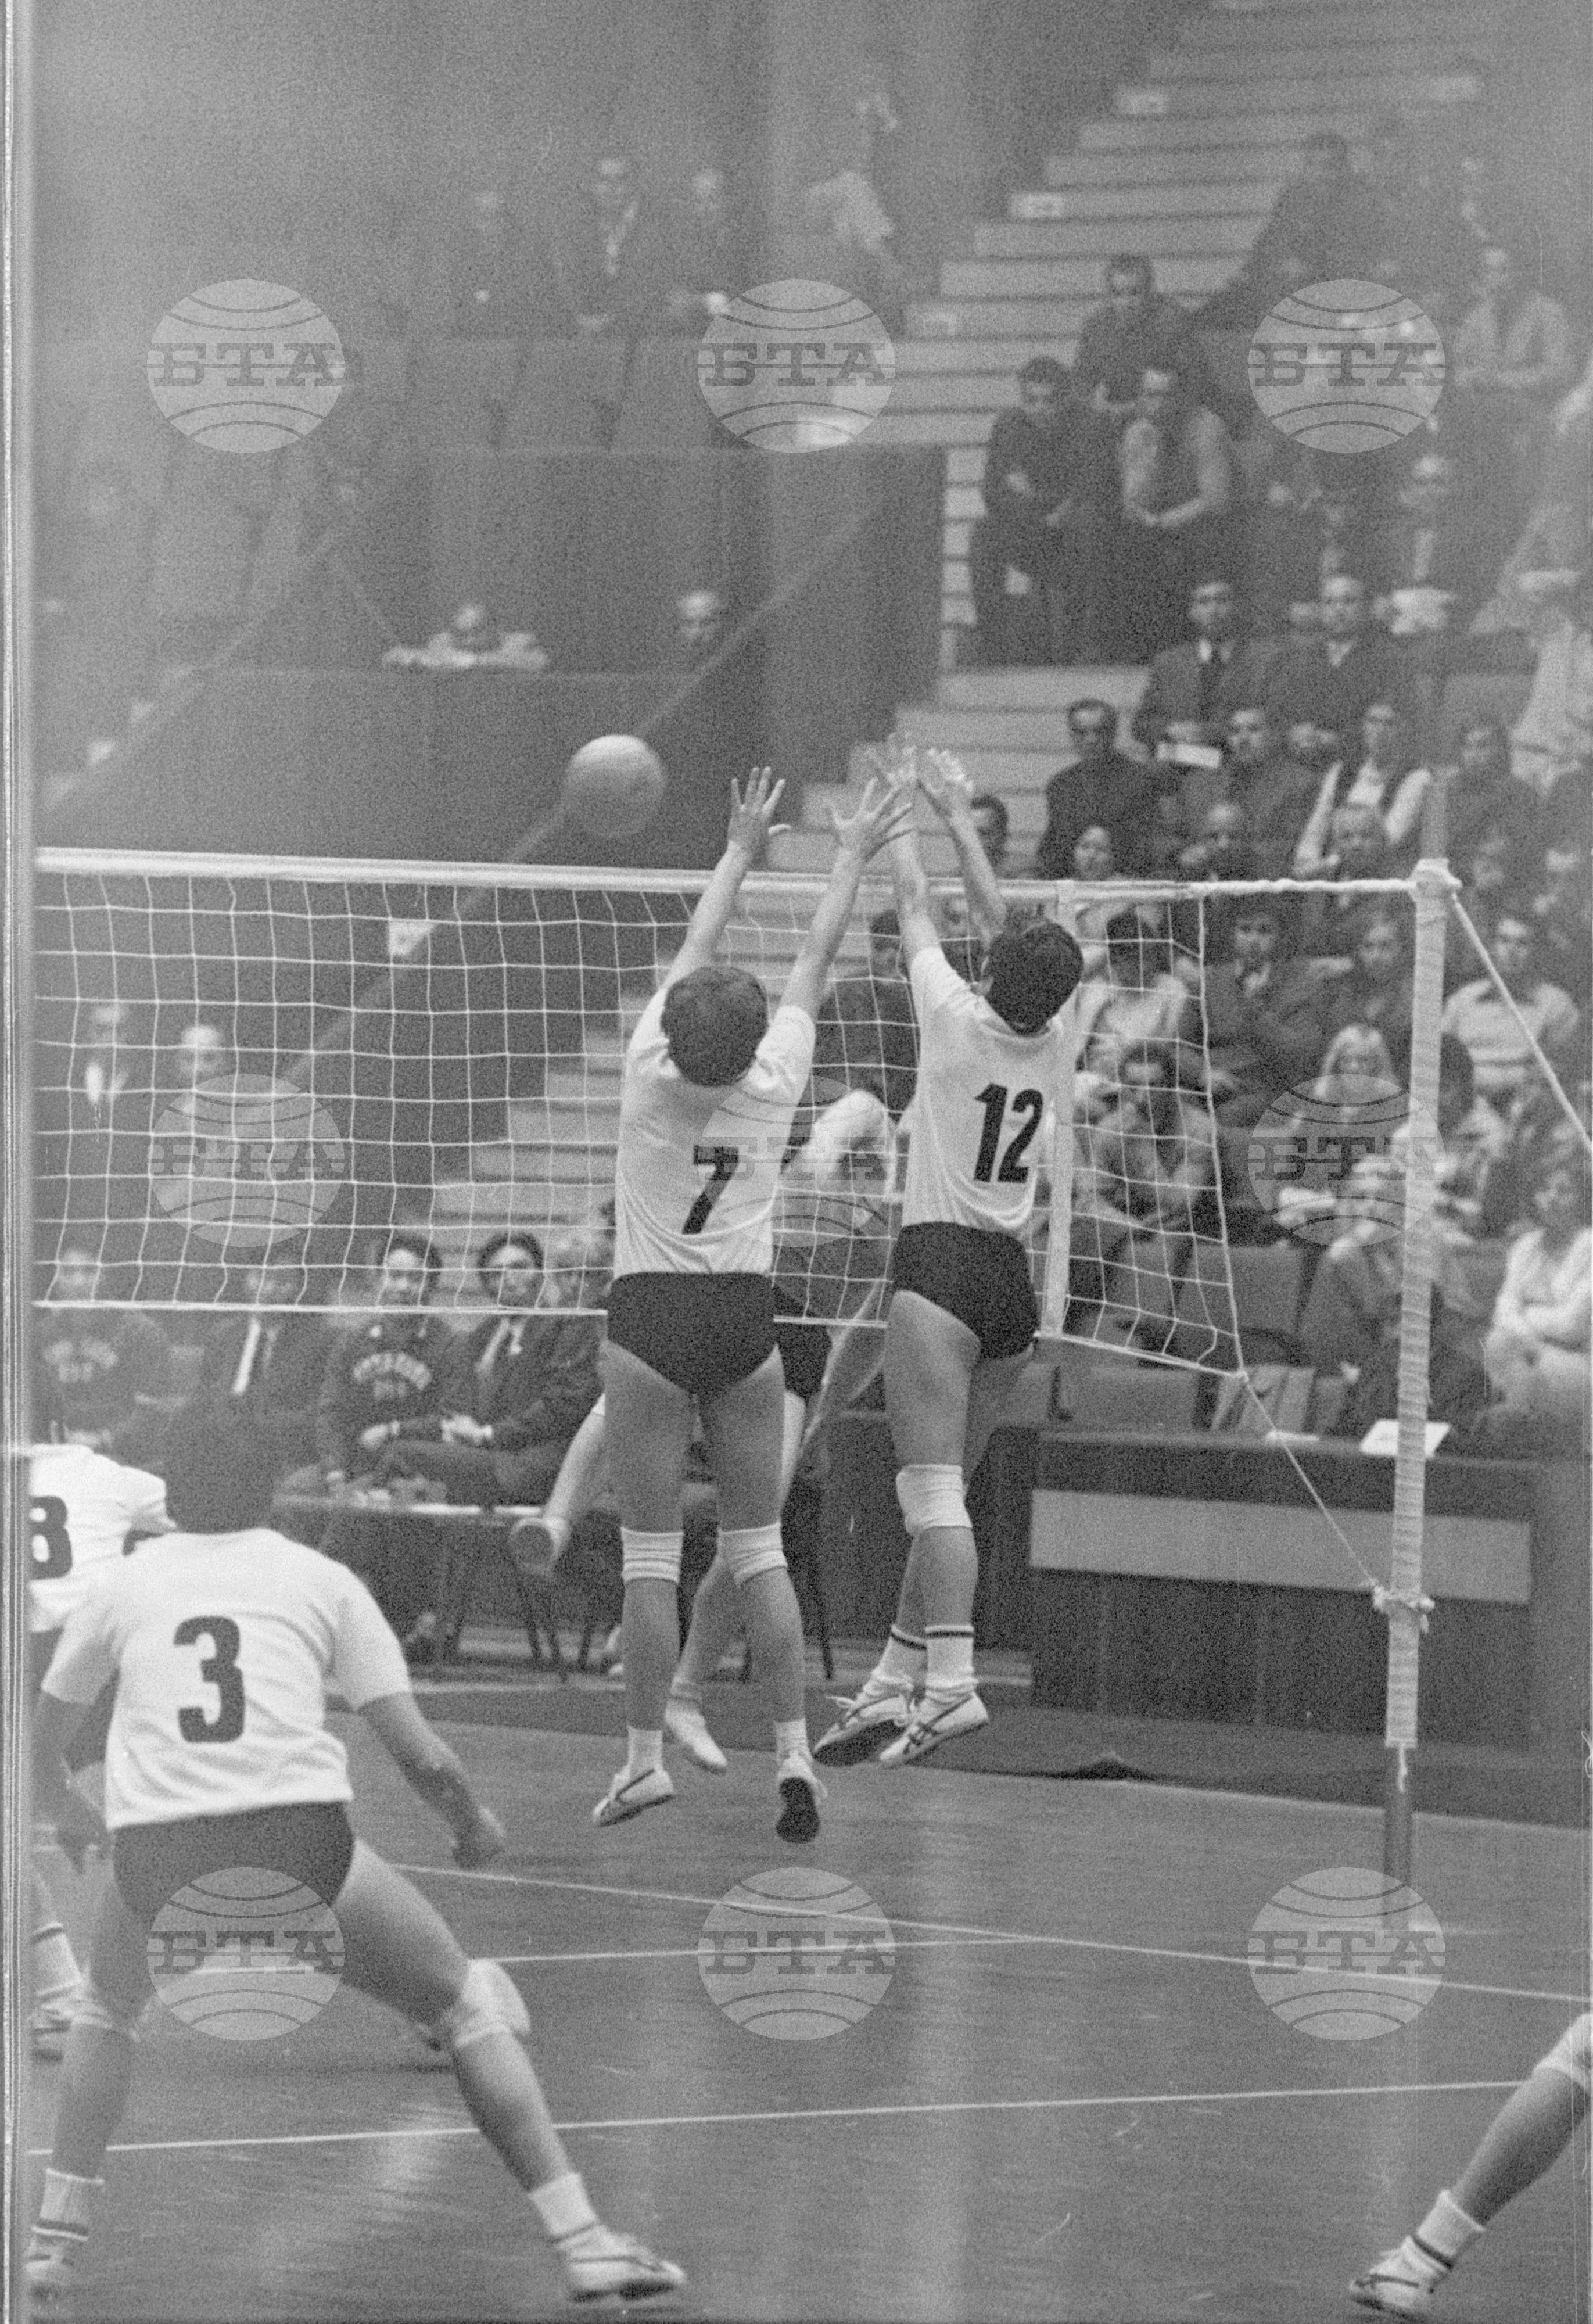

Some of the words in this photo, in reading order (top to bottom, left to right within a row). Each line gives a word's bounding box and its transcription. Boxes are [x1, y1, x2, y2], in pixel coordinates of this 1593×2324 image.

[973, 1082, 1045, 1183] 12
[681, 1144, 740, 1235] 7
[30, 1495, 73, 1580] 8
[173, 1615, 246, 1744] 3
